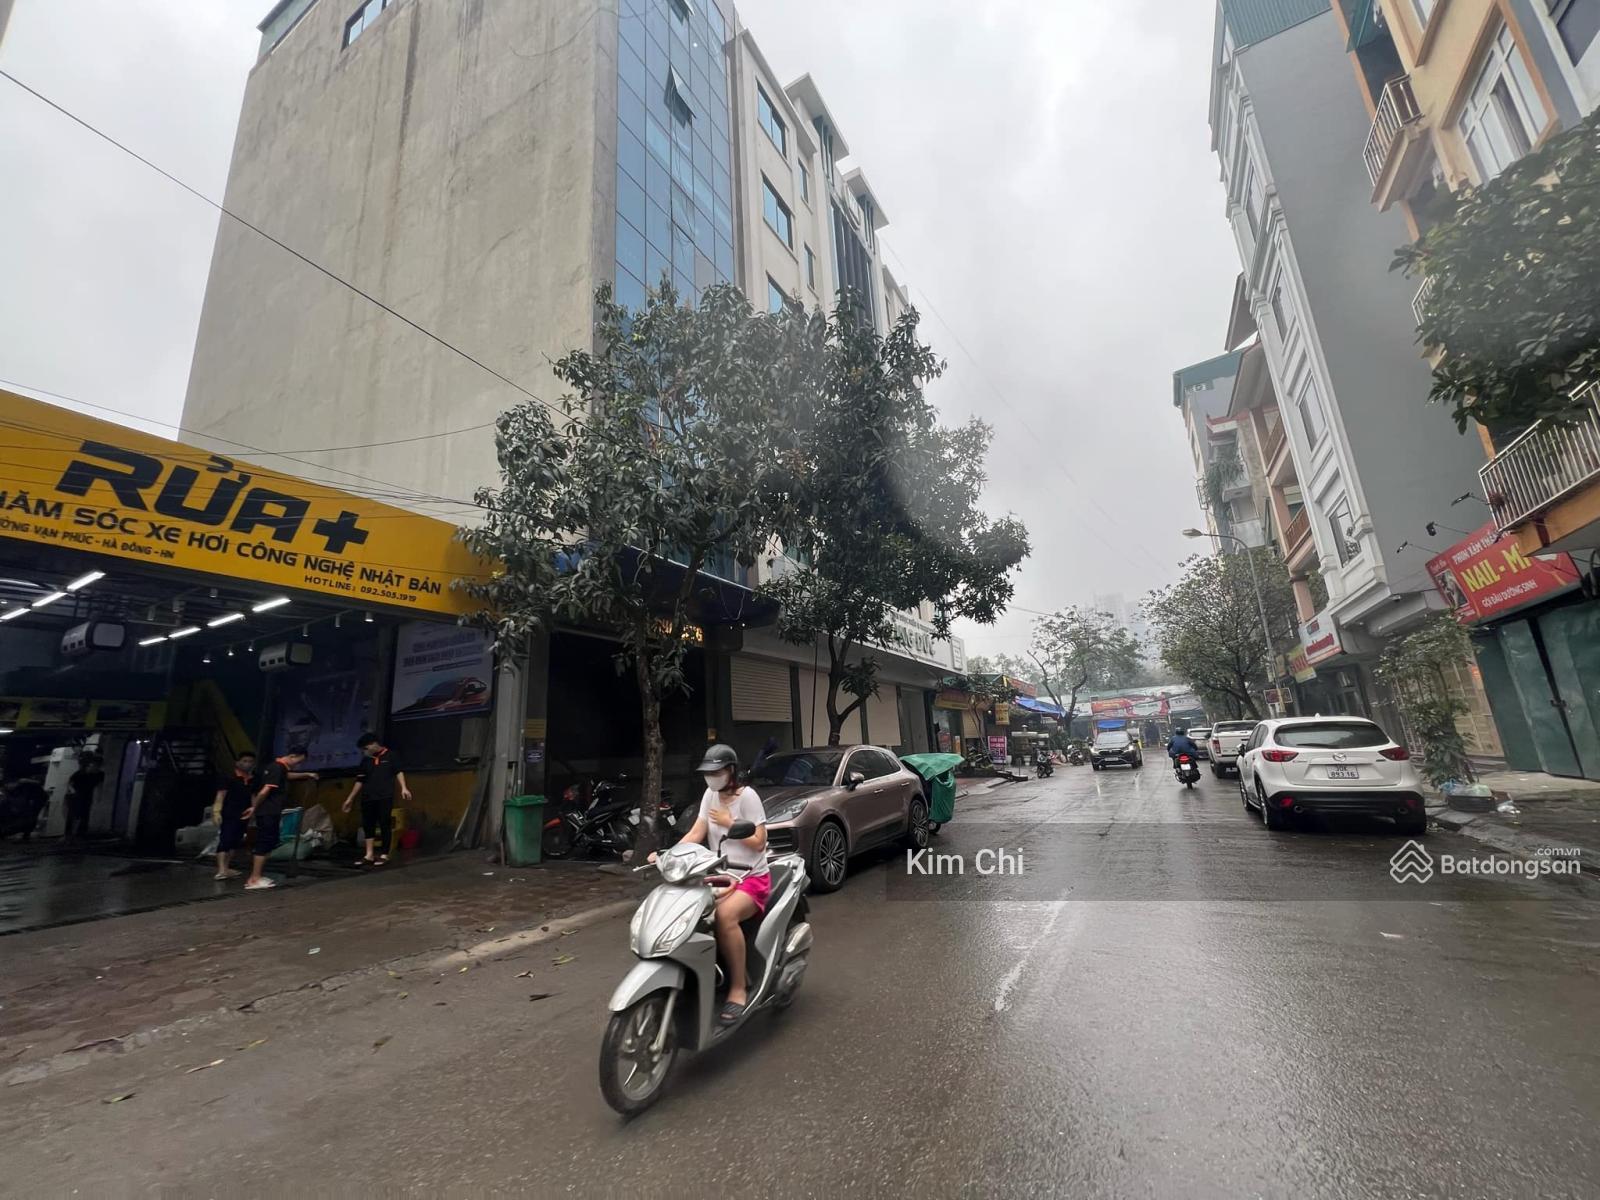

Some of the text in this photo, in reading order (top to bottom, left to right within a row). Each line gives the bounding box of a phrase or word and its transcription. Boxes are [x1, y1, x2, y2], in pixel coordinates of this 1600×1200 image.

[34, 525, 58, 539] VẠN
[61, 530, 94, 545] PHÚC
[102, 536, 118, 549] HÀ
[121, 542, 153, 555] ĐÔNG
[160, 550, 175, 559] HN
[73, 507, 139, 535] SÓC
[144, 521, 182, 544] XE
[188, 531, 229, 554] HƠI
[236, 542, 297, 567] CÔNG
[304, 555, 355, 580] NGHỆ
[360, 567, 405, 589] NHẬT
[408, 576, 442, 595] BẢN
[1460, 559, 1501, 593] NAIL
[360, 586, 417, 603] 092.505.1919
